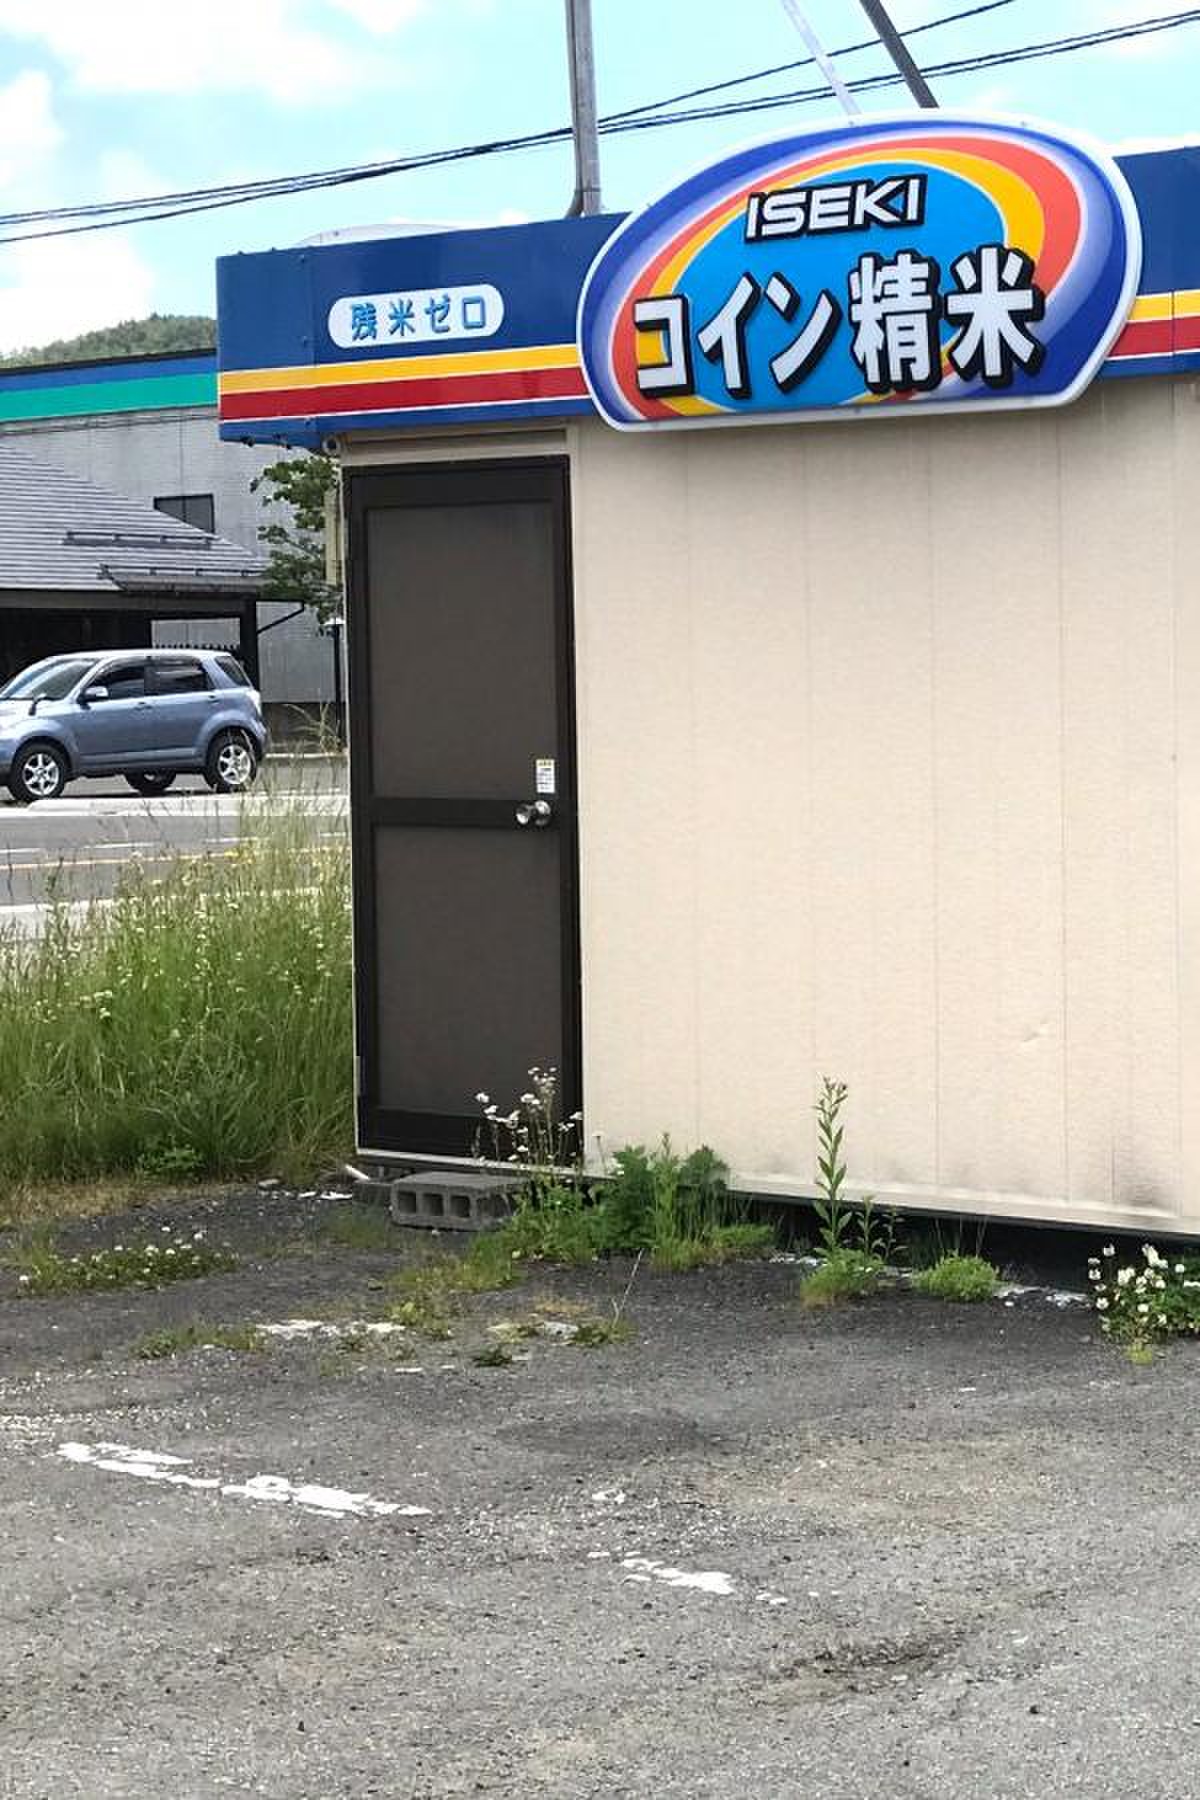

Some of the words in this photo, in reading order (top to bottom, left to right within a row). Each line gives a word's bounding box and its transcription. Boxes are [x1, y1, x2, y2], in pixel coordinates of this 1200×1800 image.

[745, 175, 924, 241] ISEKI
[350, 294, 486, 341] 残米ゼロ
[634, 245, 1042, 395] コイン精米
